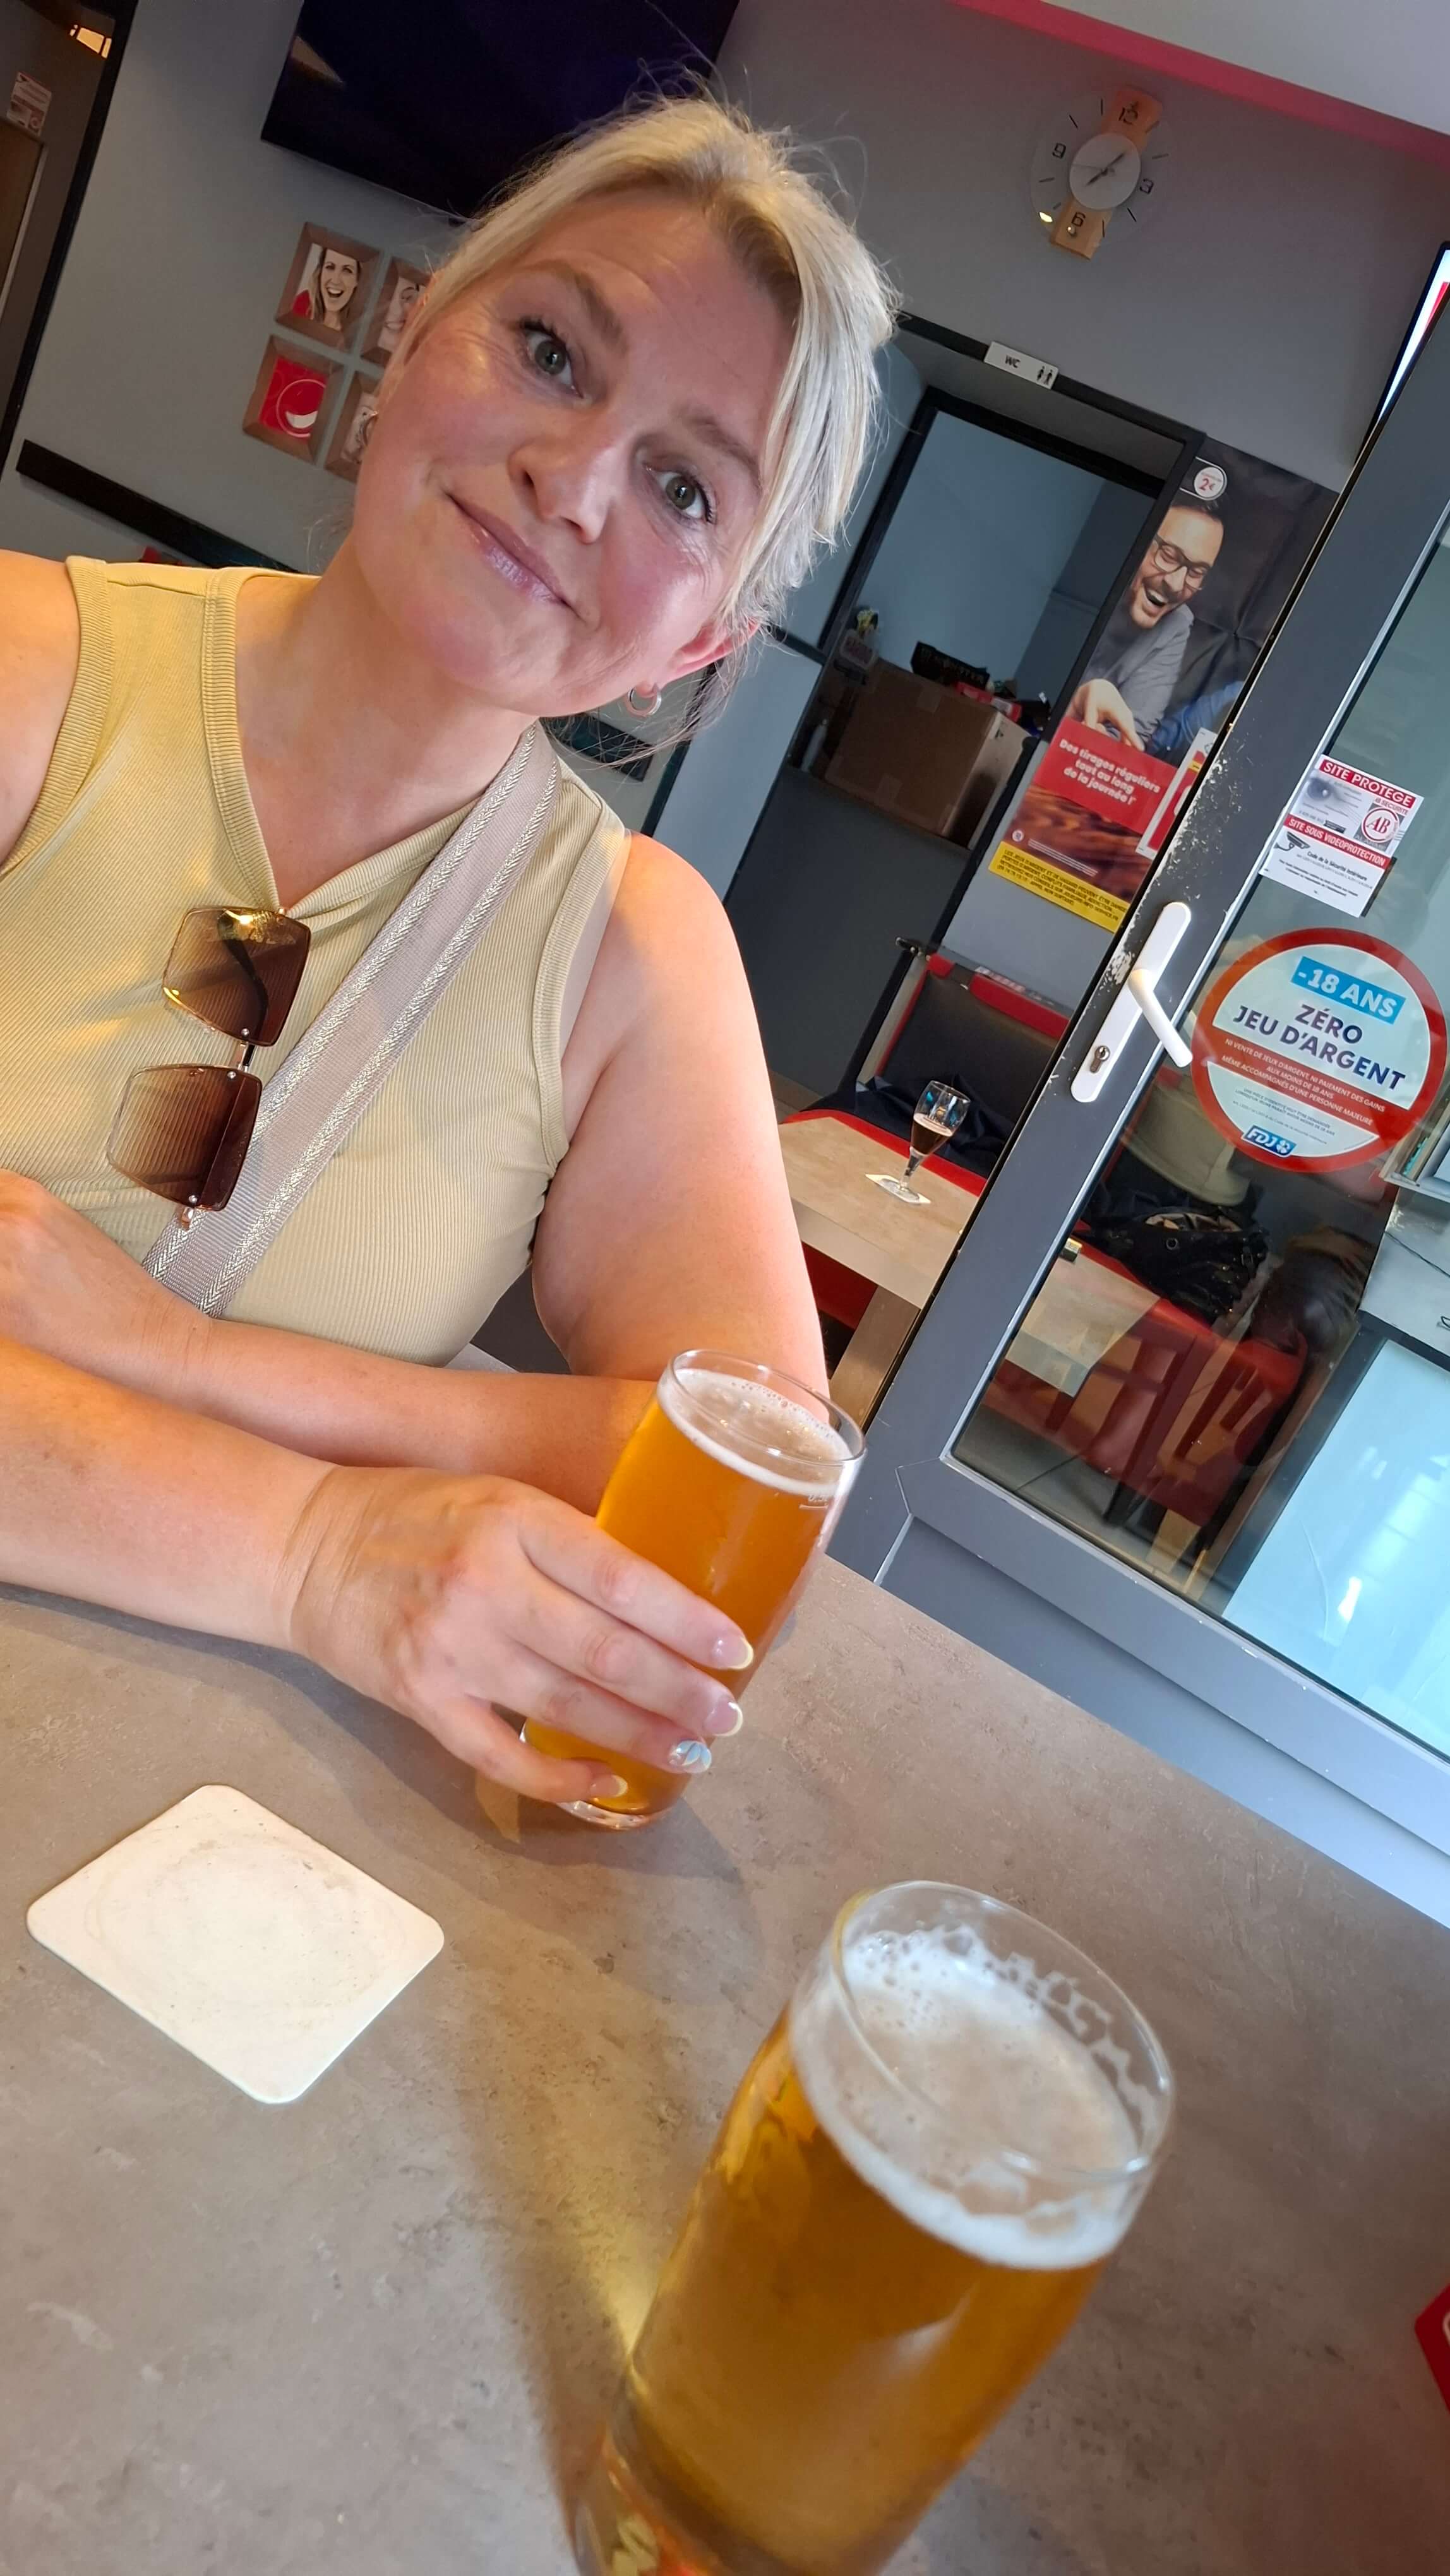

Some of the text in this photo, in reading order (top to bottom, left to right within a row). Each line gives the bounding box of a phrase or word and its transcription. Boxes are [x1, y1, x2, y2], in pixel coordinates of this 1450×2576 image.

[1052, 143, 1067, 158] 9
[1140, 178, 1154, 194] 3
[1071, 212, 1086, 227] 6
[1004, 355, 1021, 369] WC
[1058, 738, 1161, 795] Des tirages réguliers
[1062, 765, 1079, 779] de
[1077, 772, 1090, 784] la
[1086, 776, 1129, 804] journée
[1074, 759, 1135, 794] tout au long
[1323, 761, 1350, 781] SITE
[1351, 772, 1412, 807] PROTEGE
[1288, 817, 1305, 832] SITE
[1303, 823, 1324, 840] SOUS
[1322, 832, 1386, 866] VIDEOPROTECTION
[1367, 815, 1391, 834] AB
[1306, 850, 1318, 860] Code
[1298, 969, 1397, 1018] -18 ANS
[1295, 1005, 1363, 1044] ZÉRO
[1232, 1005, 1406, 1090] JEU D'ARGENT
[1221, 1052, 1242, 1068] MÊME
[1240, 1062, 1290, 1089] ACCOMPAGNÉS
[1308, 1093, 1343, 1112] PERSONNE
[1341, 1107, 1373, 1126] MAJEURE
[1225, 1038, 1233, 1046] NI
[1232, 1041, 1254, 1055] VENTE
[1252, 1050, 1263, 1059] DE
[1262, 1054, 1278, 1066] JEUX
[1309, 1075, 1319, 1083] NI
[1317, 1078, 1351, 1097] PAIEMENT
[1350, 1092, 1364, 1103] DES
[1362, 1098, 1386, 1112] GAINS
[1266, 1064, 1281, 1076] AUX
[1280, 1071, 1303, 1085] MOINS
[1302, 1080, 1313, 1090] DE
[1319, 1088, 1334, 1099] ANS
[1247, 1127, 1278, 1148] FDJ
